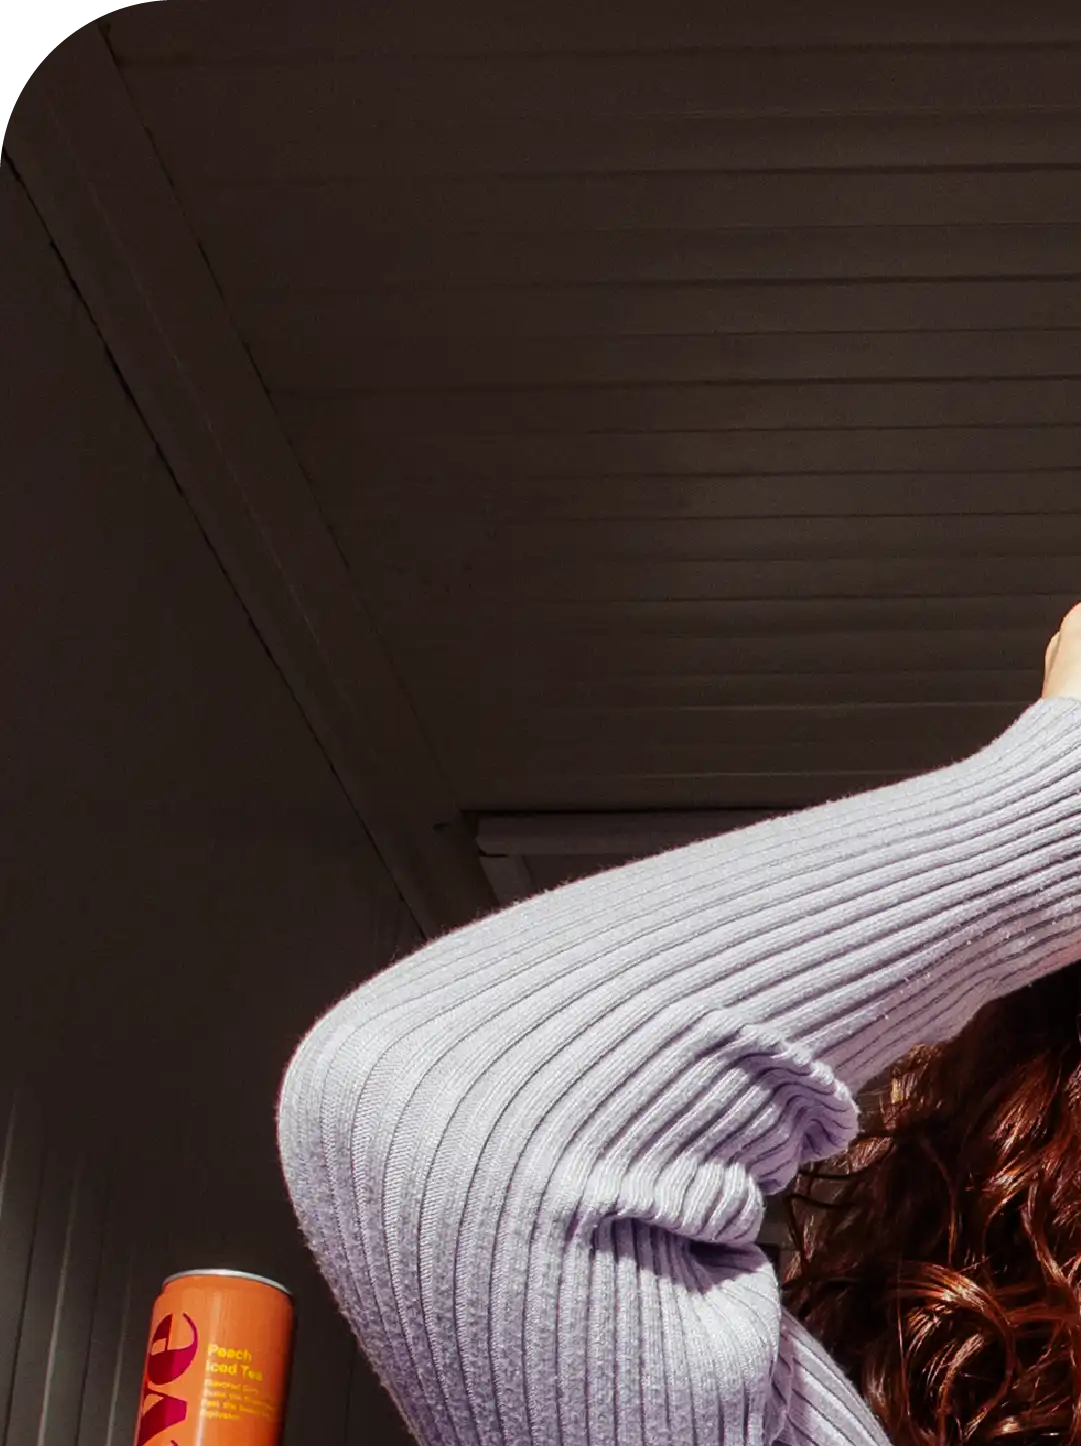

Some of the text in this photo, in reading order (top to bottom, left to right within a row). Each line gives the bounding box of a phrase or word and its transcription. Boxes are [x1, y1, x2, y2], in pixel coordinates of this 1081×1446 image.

[207, 1343, 252, 1363] Peach
[206, 1359, 263, 1381] Iced Tea
